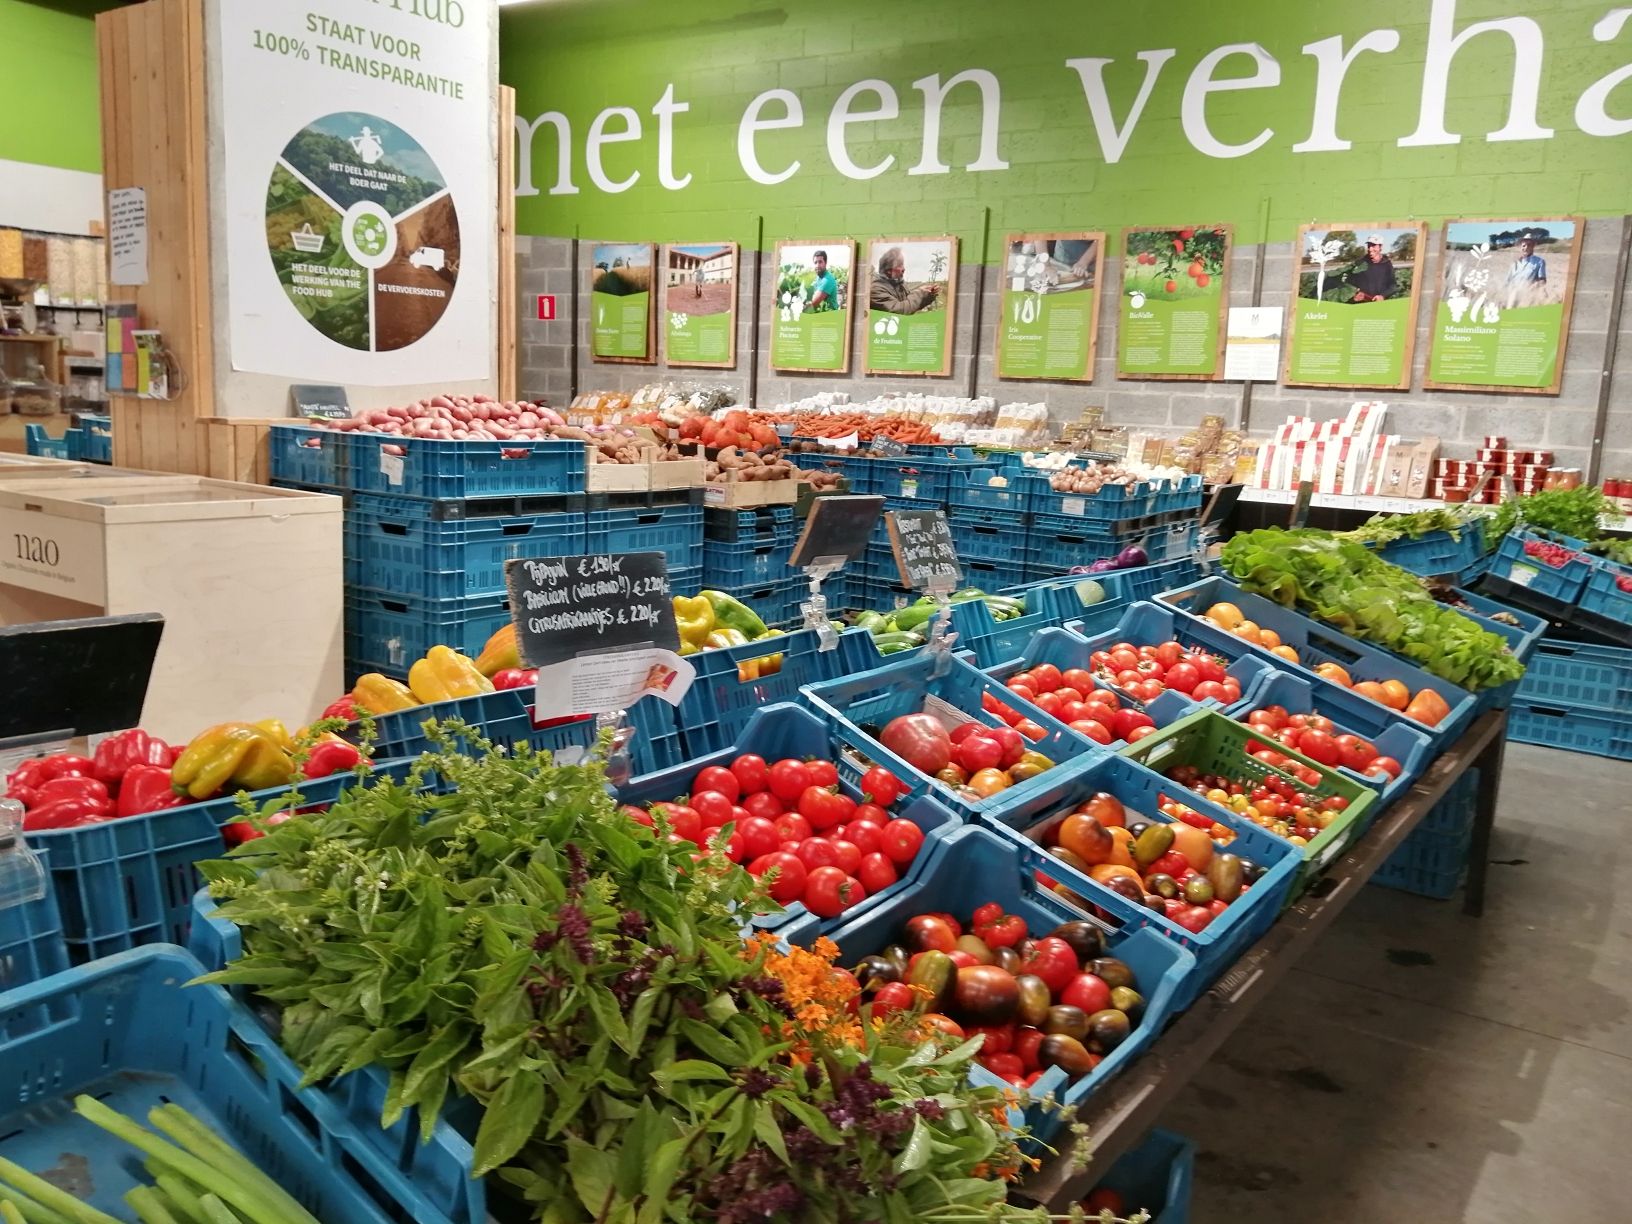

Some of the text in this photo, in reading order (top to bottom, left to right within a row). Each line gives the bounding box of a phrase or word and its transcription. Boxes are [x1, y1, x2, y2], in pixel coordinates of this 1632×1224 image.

[306, 13, 421, 61] STAAT VOOR
[253, 29, 464, 100] 100% TRANSPARANTIE
[737, 68, 1010, 185] een
[329, 162, 407, 184] HET DEEL DAT NAAR DE
[349, 177, 389, 191] BOER GAAT
[292, 263, 361, 278] HET DEEL VOOR DE
[291, 274, 361, 289] WERKING VAN THE
[292, 286, 333, 297] FOOD HUB
[377, 283, 445, 298] DE VERVOERSKOSTEN
[1444, 326, 1497, 334] Massimiliano
[1443, 334, 1471, 342] Solano
[14, 533, 59, 567] nao
